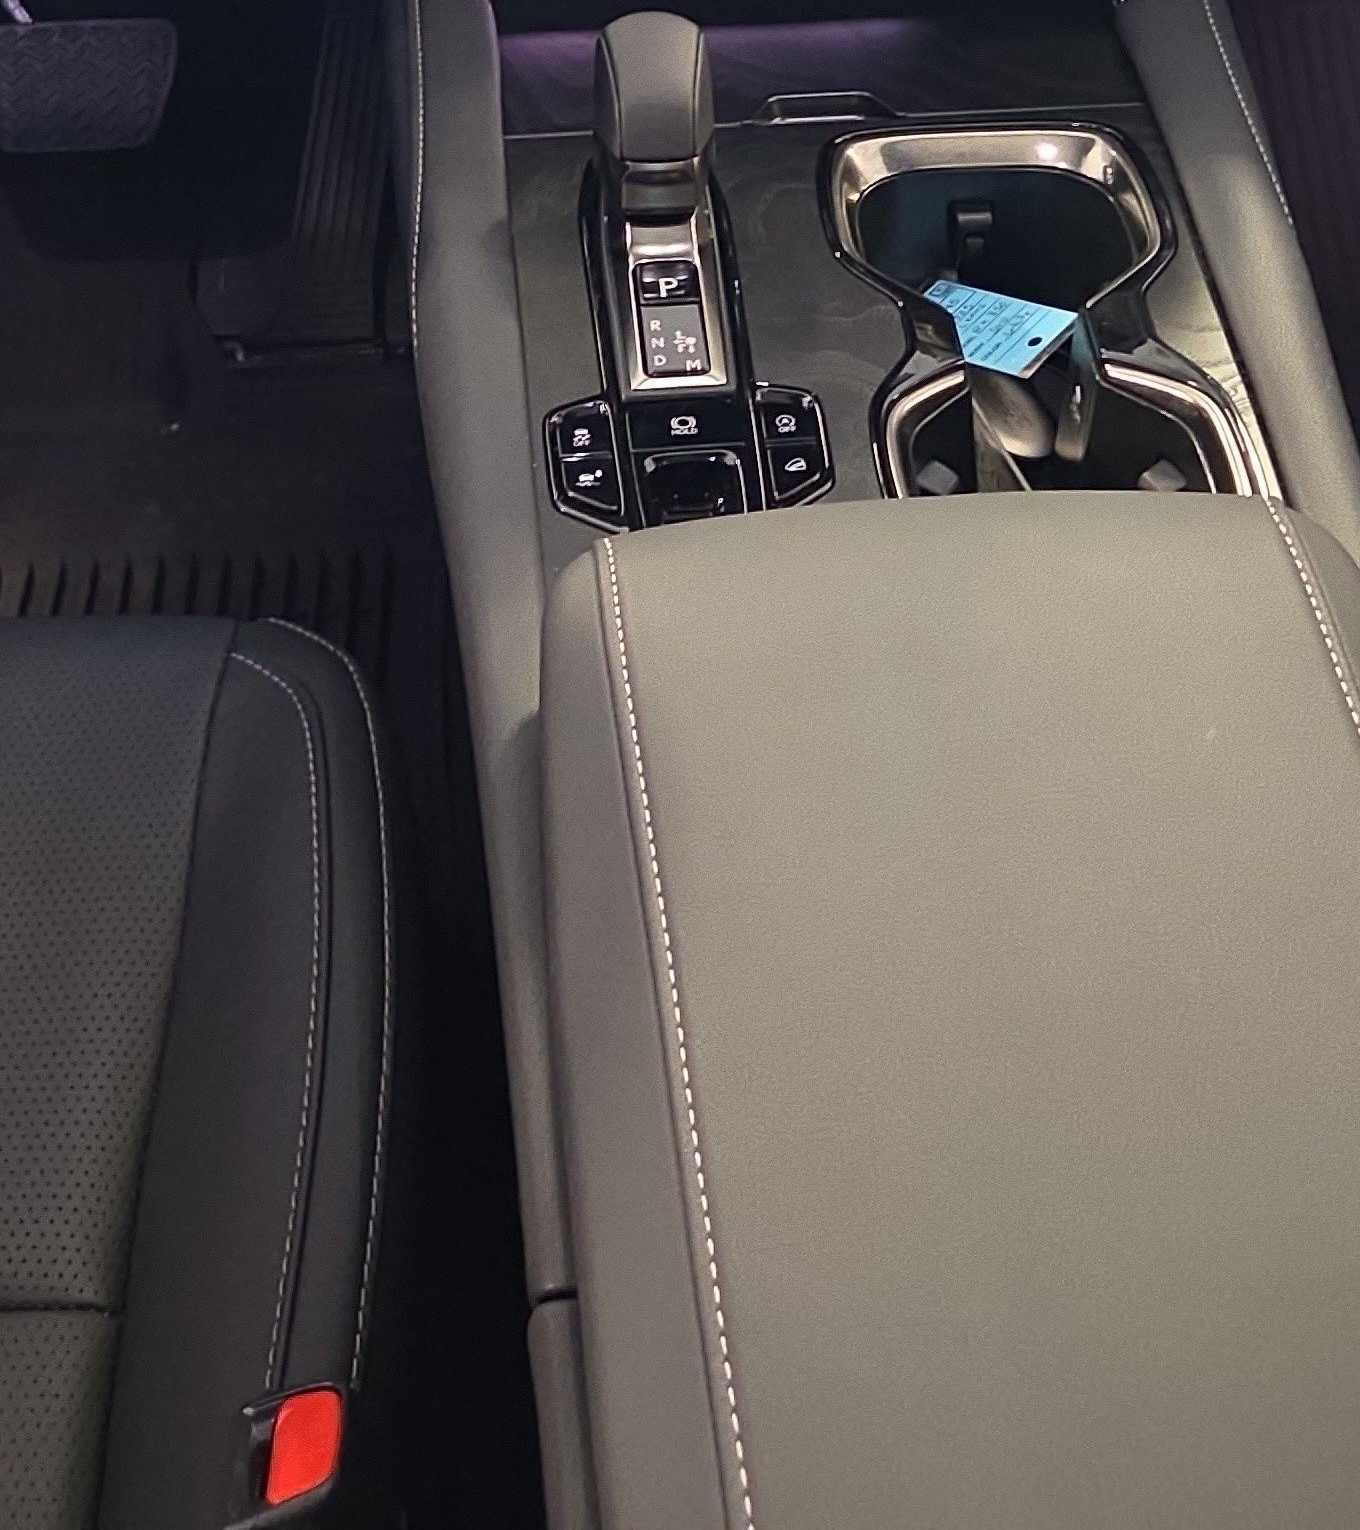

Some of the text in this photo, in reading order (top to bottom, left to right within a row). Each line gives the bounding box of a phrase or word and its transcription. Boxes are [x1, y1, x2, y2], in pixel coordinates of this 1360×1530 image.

[658, 276, 679, 298] P
[649, 319, 661, 331] R
[651, 336, 666, 349] N
[653, 354, 667, 367] D
[685, 359, 703, 372] M
[670, 427, 699, 436] HOLD
